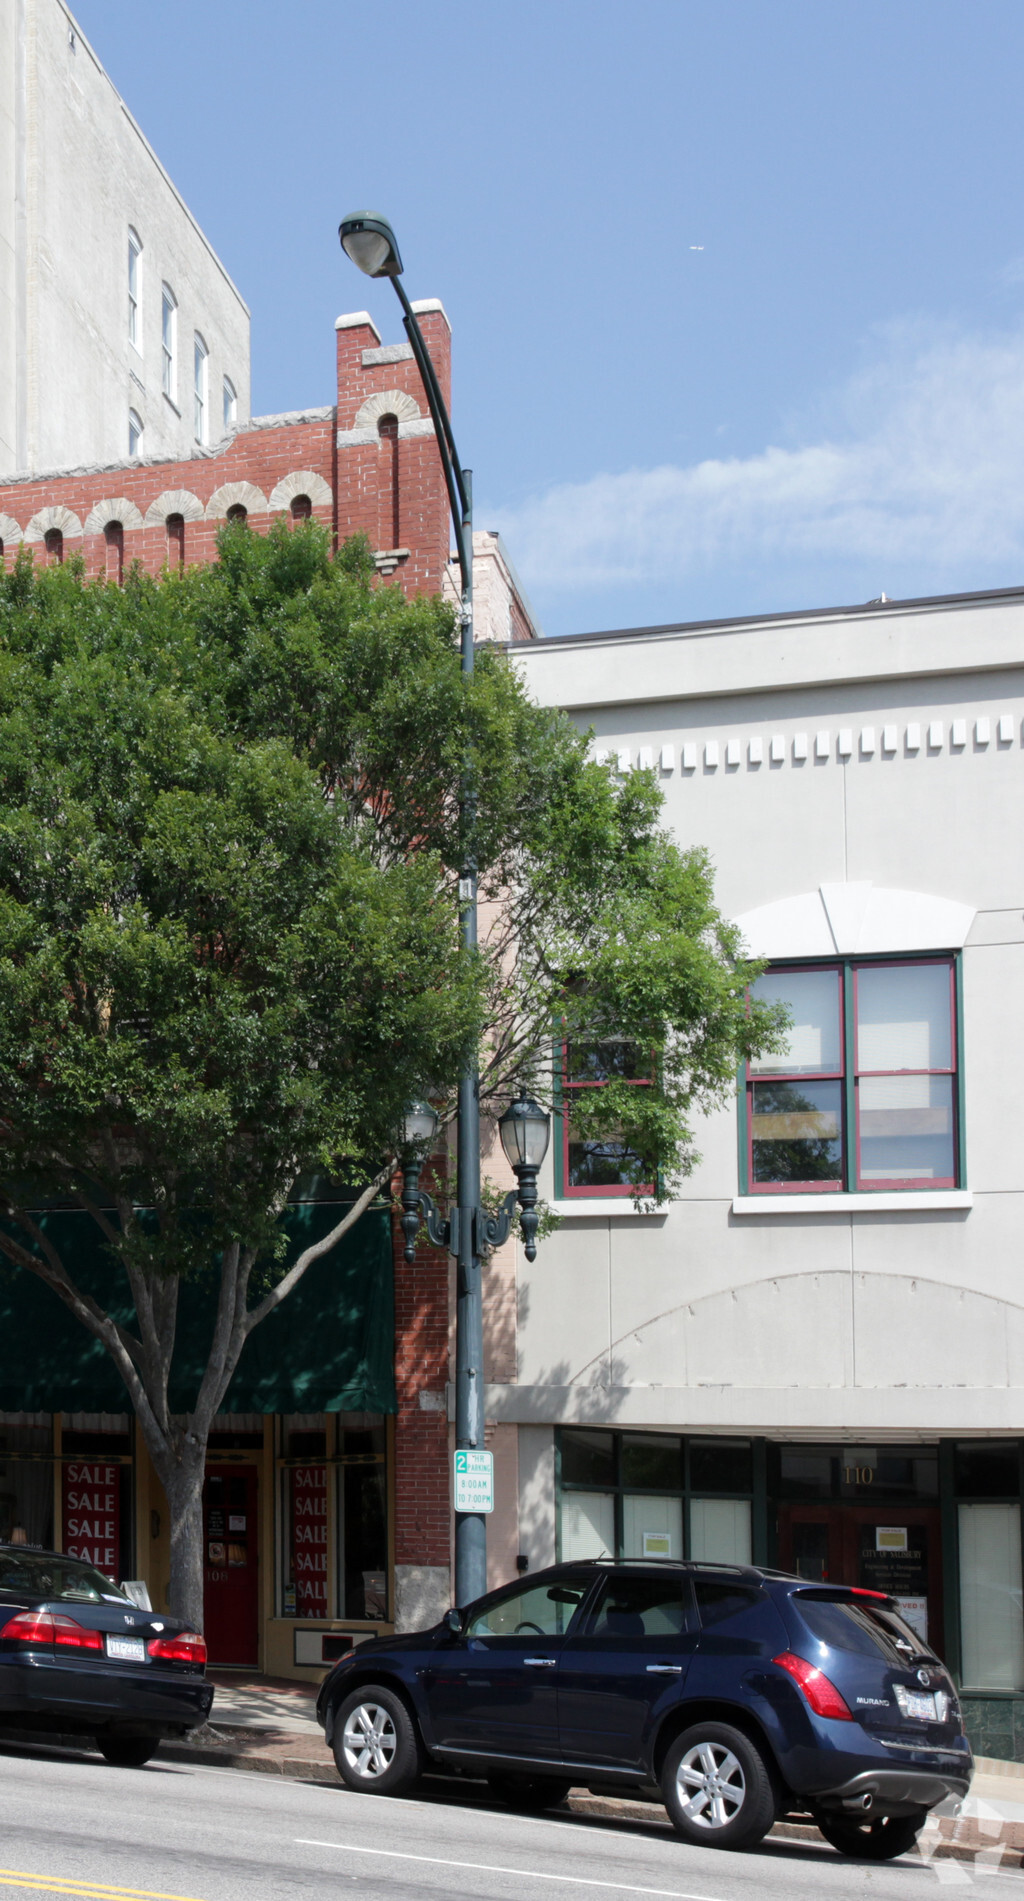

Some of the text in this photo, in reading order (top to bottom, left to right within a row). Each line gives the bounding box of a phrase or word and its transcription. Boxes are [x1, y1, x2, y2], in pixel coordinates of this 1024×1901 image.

[457, 1455, 466, 1471] 2
[468, 1464, 491, 1472] PARKING
[67, 1464, 115, 1485] SALE
[845, 1466, 873, 1485] 110
[67, 1491, 115, 1512] SALE
[458, 1493, 466, 1503] TO
[67, 1518, 115, 1539] SALE
[67, 1545, 115, 1566] SALE
[856, 1696, 890, 1707] MURANO
